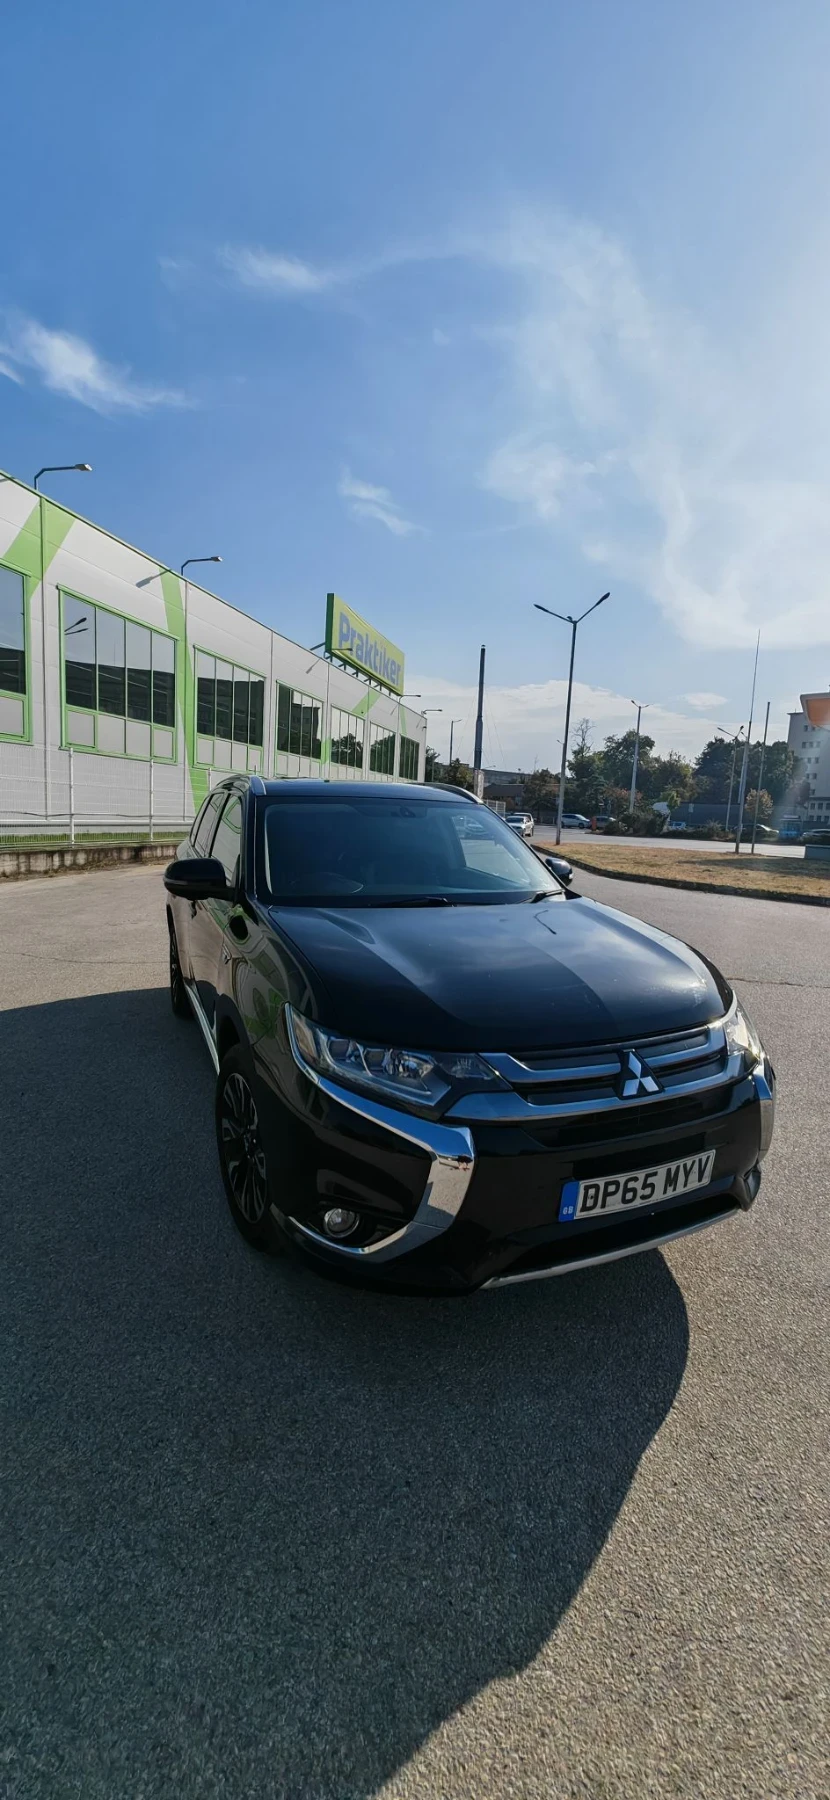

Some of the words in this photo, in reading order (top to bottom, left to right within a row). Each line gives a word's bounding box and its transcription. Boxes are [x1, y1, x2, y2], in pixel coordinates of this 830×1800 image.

[338, 612, 401, 686] Praktiker
[562, 1205, 574, 1215] GB
[580, 1171, 658, 1213] DP65
[662, 1155, 711, 1195] MYV
